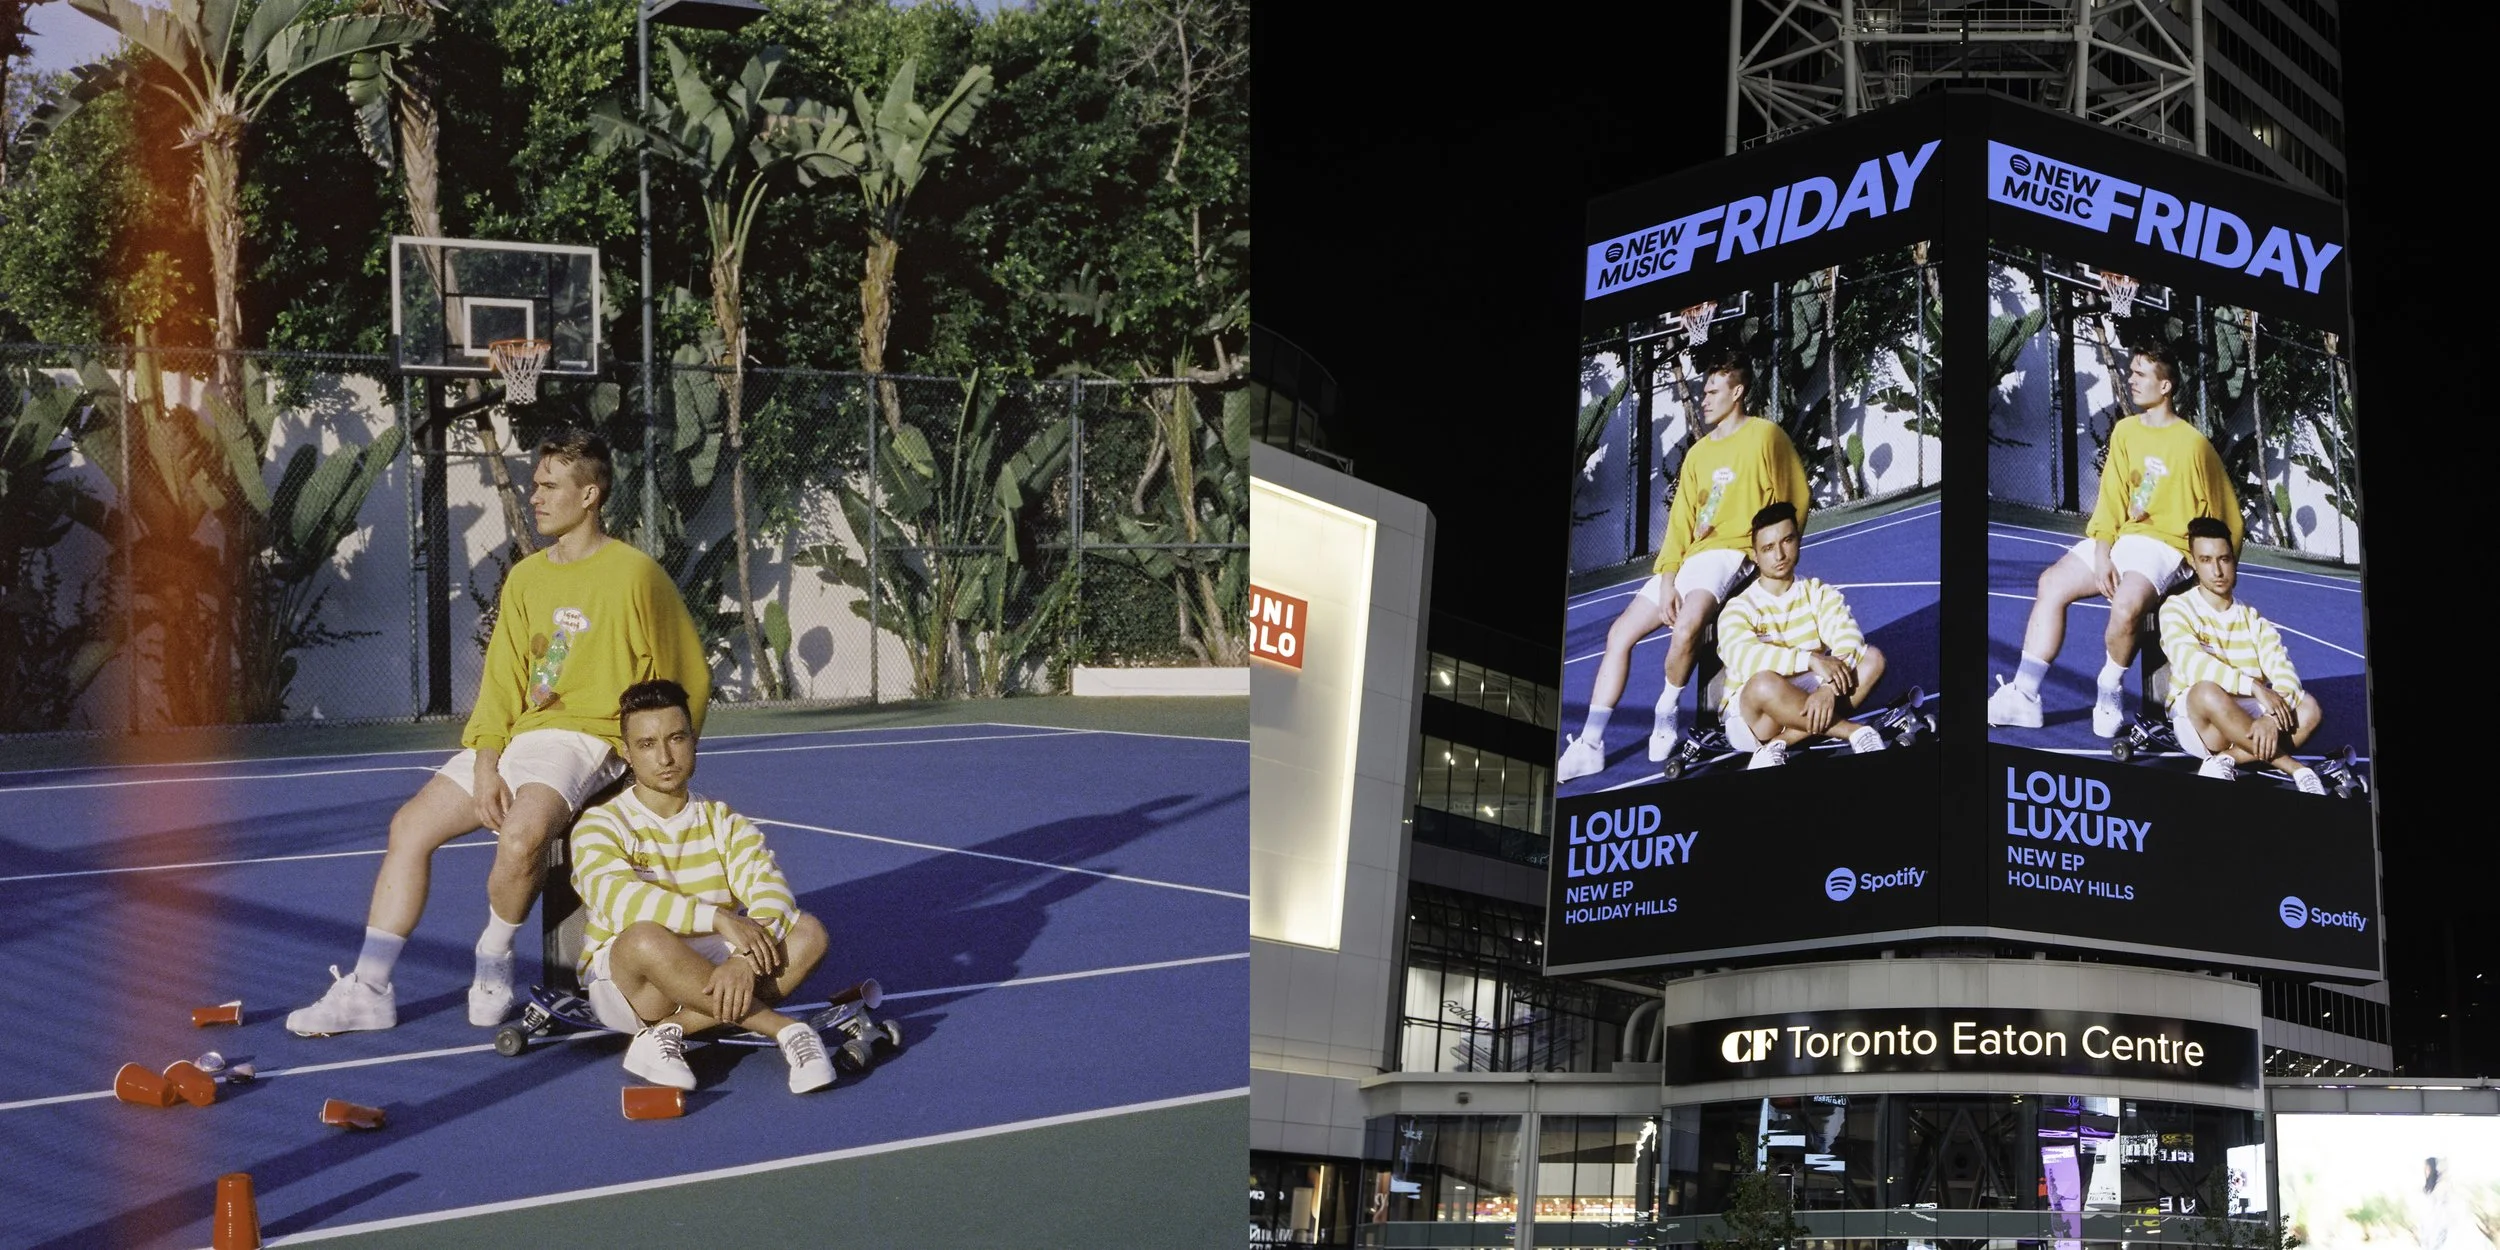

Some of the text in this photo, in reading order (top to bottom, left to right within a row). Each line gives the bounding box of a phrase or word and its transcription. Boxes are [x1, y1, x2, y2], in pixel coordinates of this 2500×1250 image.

[2002, 176, 2093, 219] MUSIC
[2034, 161, 2101, 198] NEW
[1676, 139, 1942, 271] FRIDAY
[1625, 222, 1687, 260] NEW
[2092, 174, 2343, 295] FRIDAY
[1597, 248, 1678, 290] MUSIC
[2007, 766, 2112, 812] LOUD
[1569, 804, 1662, 846] LOUD
[2007, 801, 2152, 853] LUXURY
[1567, 830, 1699, 878] LUXURY
[2007, 845, 2085, 872] NEW EP
[1566, 880, 1634, 905] NEW EP
[1859, 867, 1926, 893] Spotify
[2008, 870, 2135, 901] HOLIDAY HILLS
[1565, 897, 1678, 925] HOLIDAY HILLS
[2310, 907, 2367, 933] Spotify
[1721, 1021, 2205, 1067] CF Toronto Eaton Centre
